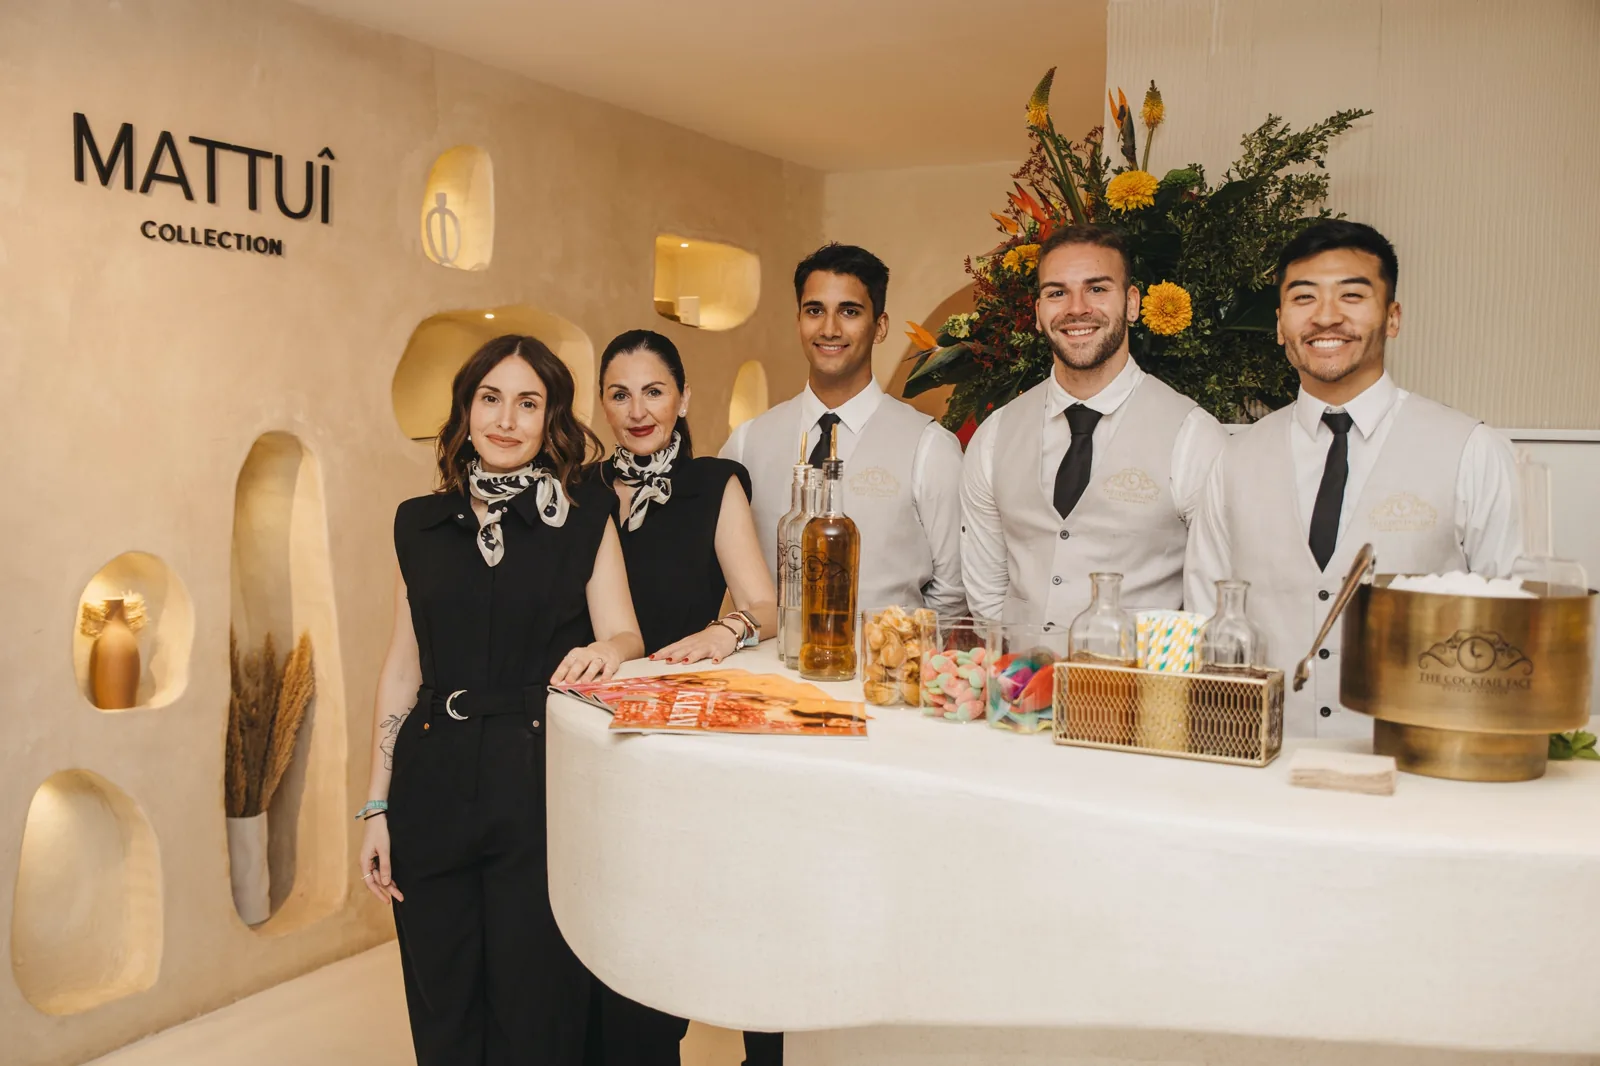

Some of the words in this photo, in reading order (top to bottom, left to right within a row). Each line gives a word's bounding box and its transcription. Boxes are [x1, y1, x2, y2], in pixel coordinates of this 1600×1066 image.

[73, 112, 335, 224] MATTUÎ
[140, 220, 282, 255] COLLECTION
[1420, 672, 1440, 683] THE
[1444, 675, 1501, 688] COCKTAIL
[1506, 677, 1532, 690] FACE
